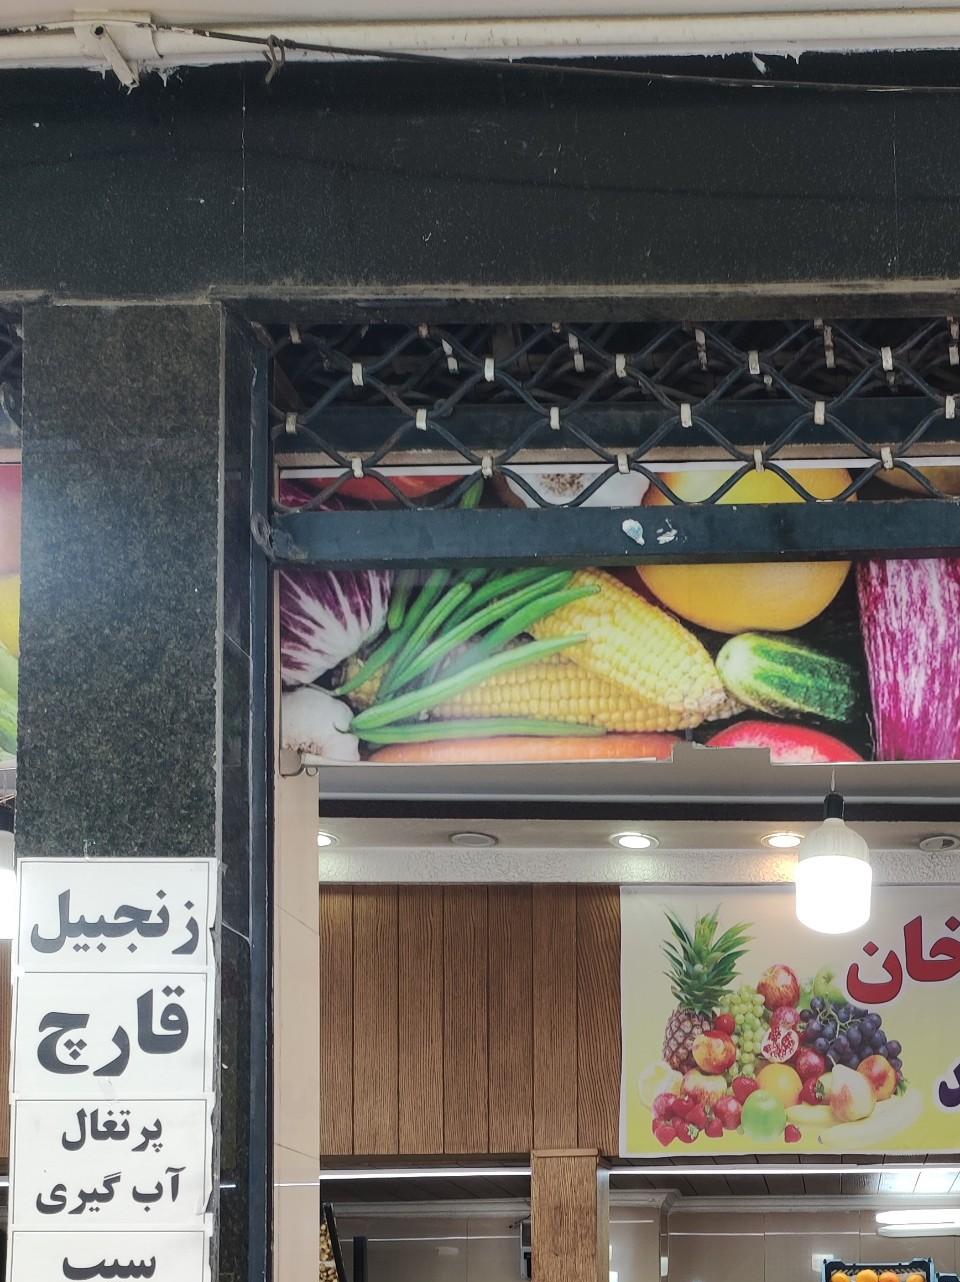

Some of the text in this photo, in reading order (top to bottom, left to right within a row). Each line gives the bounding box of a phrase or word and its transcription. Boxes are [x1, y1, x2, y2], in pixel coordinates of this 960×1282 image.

[31, 889, 199, 954] زنجبیل
[37, 985, 188, 1076] قارچ
[61, 1108, 163, 1152] پرتغال
[36, 1167, 186, 1214] آب گیری
